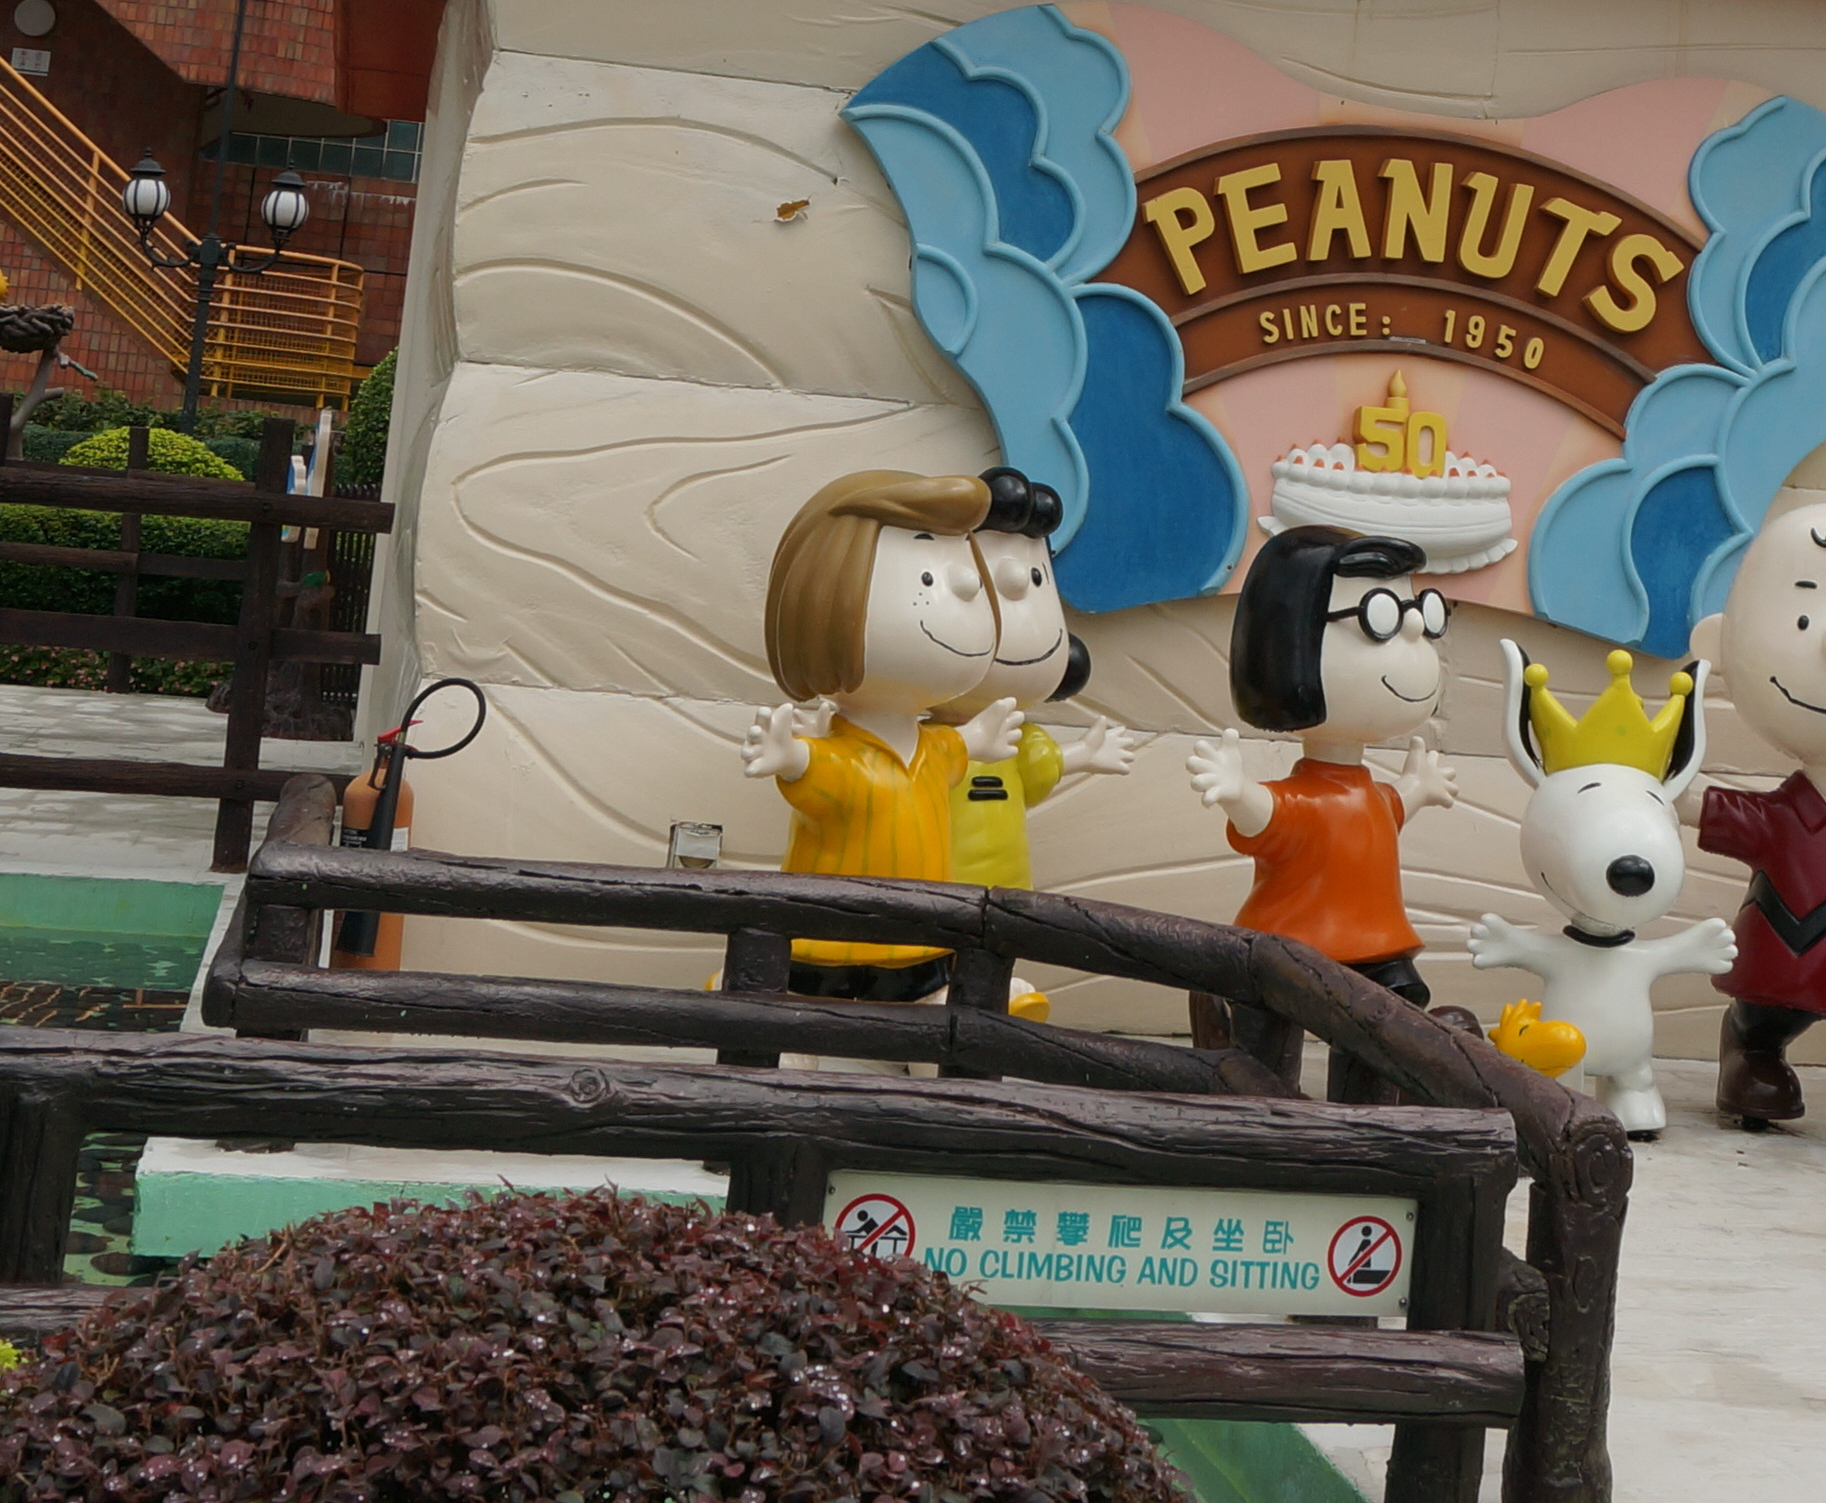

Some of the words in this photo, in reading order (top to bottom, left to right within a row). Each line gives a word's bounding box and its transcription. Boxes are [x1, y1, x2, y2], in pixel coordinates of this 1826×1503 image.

[1142, 158, 1685, 333] PEANUTS
[1259, 302, 1393, 345] SINCE:
[1443, 308, 1546, 371] 1950
[1353, 405, 1448, 479] 50
[925, 1247, 968, 1278] NO
[978, 1248, 1127, 1285] CLIMBING
[1136, 1255, 1199, 1288] AND
[1208, 1259, 1321, 1291] SITTING
